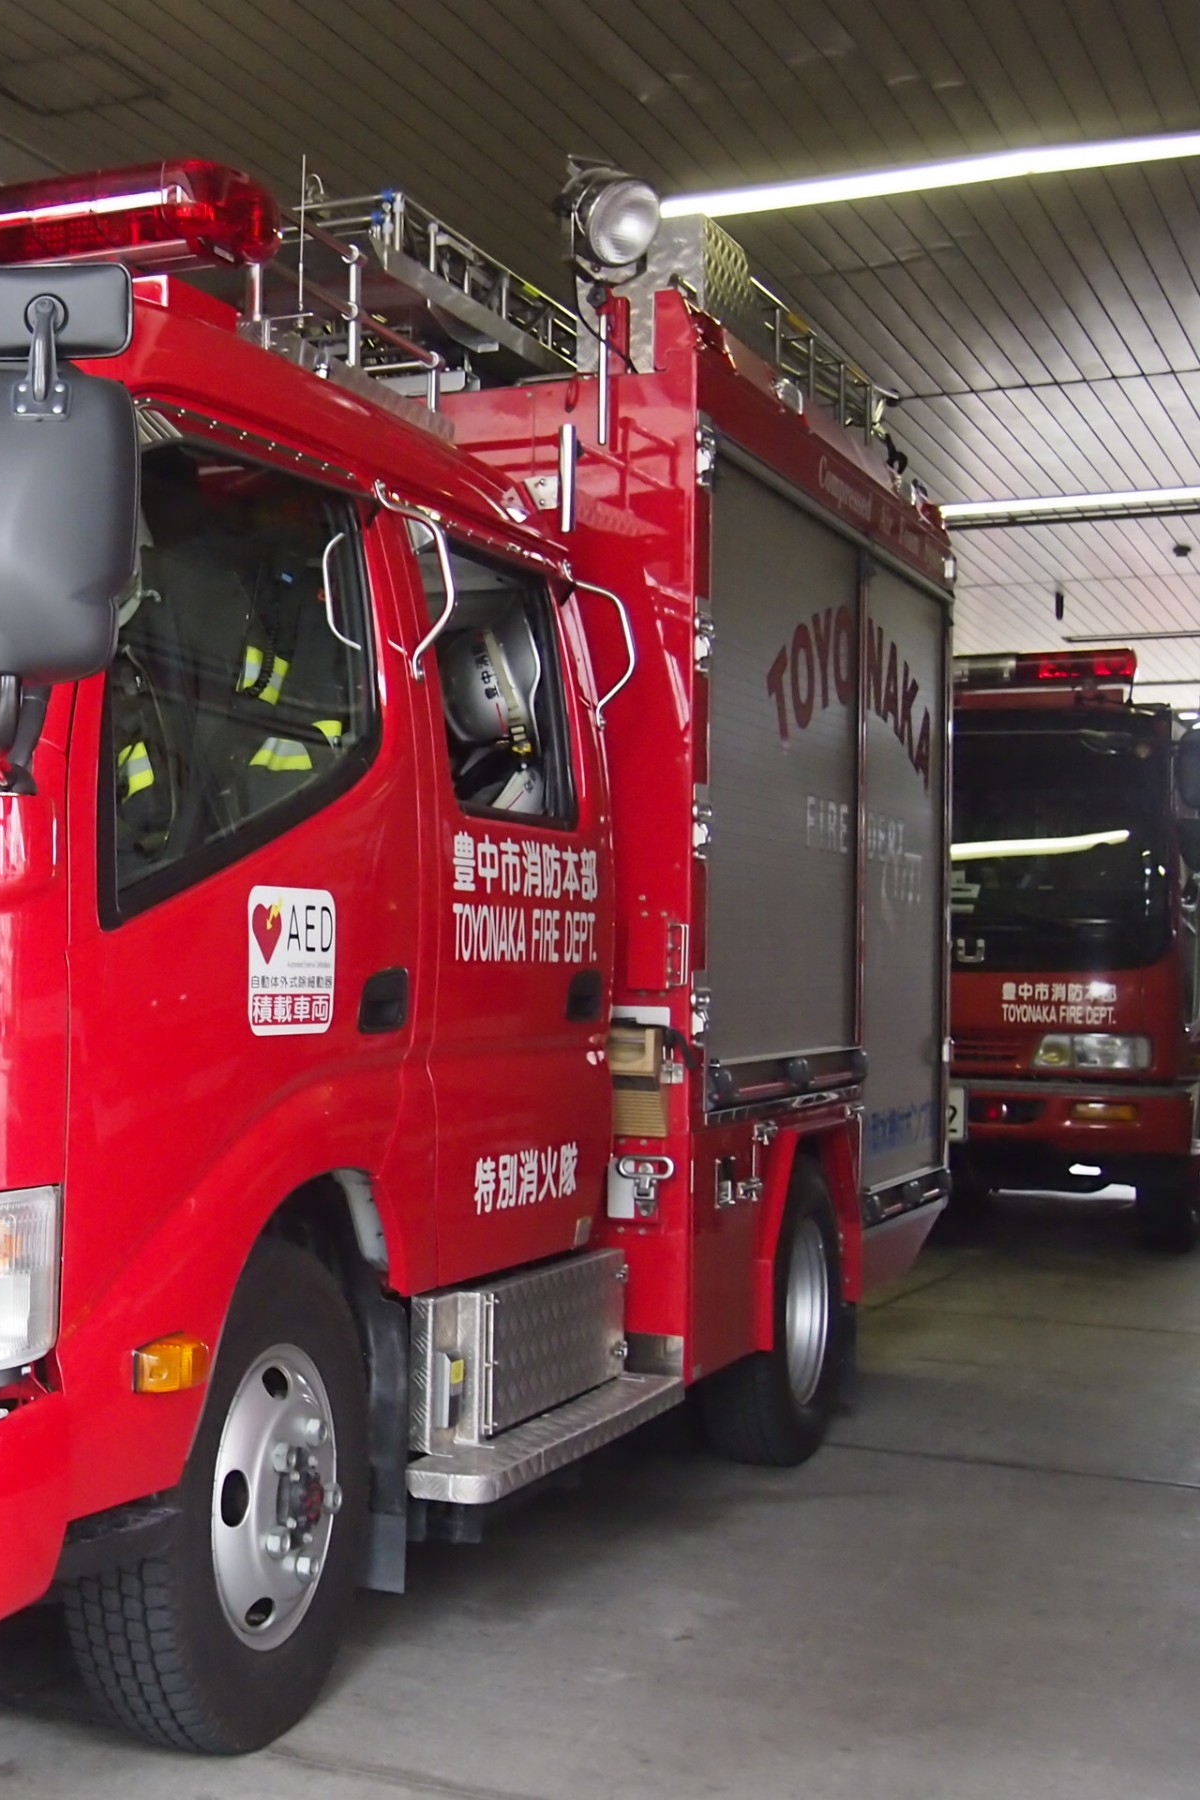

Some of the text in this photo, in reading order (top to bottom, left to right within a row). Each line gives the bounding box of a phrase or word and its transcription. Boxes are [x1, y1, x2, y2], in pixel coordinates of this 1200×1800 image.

[766, 605, 931, 792] TOYONAKA
[806, 796, 848, 854] FIRE
[453, 830, 598, 902] 豊中市消防本部
[287, 904, 333, 953] AED
[452, 902, 598, 963] TOYONAKA FIRE DEPT.
[252, 994, 330, 1024] 積載車両
[1002, 1003, 1118, 1026] TOYONAKA FIRE DEPT.
[474, 1141, 578, 1216] 特別消火隊
